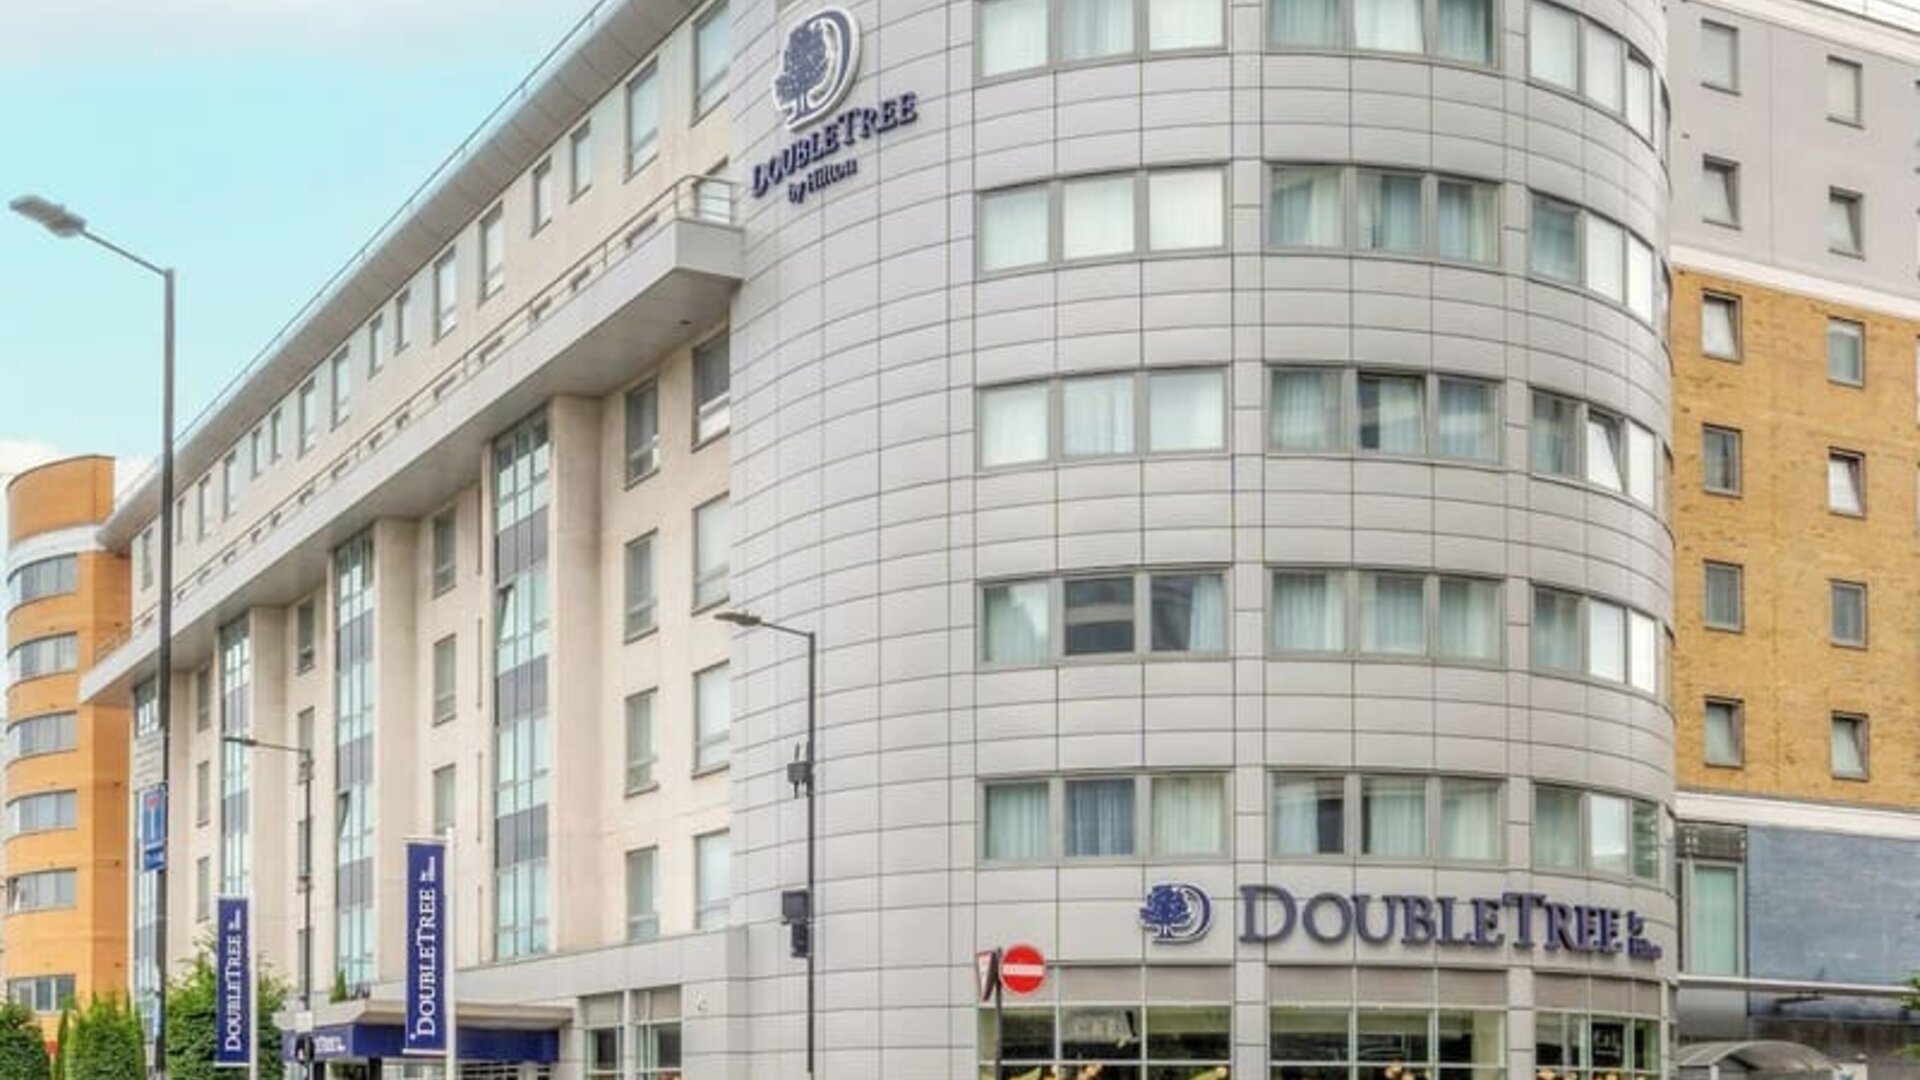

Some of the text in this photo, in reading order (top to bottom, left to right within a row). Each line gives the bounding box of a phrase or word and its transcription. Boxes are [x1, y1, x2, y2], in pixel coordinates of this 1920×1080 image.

[753, 92, 918, 198] DOUBLETREE
[417, 888, 436, 1036] DOUBLETREE
[1238, 884, 1623, 955] DOUBLETREE
[225, 935, 242, 1051] DOUBLETREE
